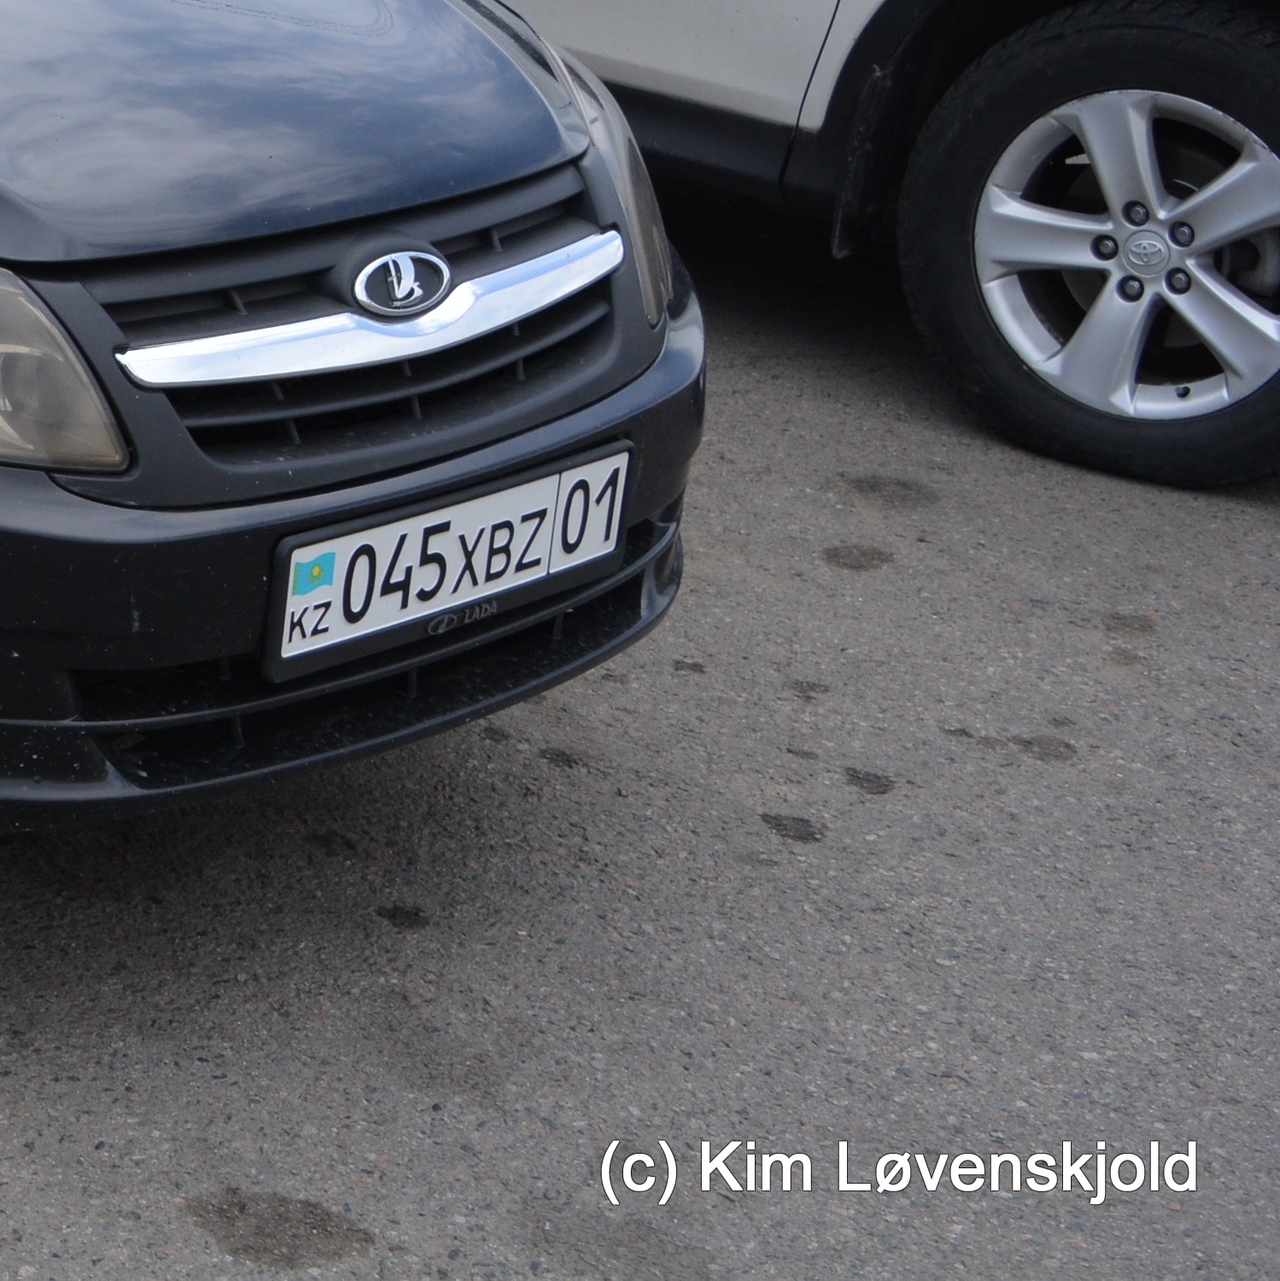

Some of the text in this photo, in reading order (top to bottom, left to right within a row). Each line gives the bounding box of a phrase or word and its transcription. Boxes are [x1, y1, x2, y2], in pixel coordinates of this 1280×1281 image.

[560, 466, 622, 555] 01
[287, 600, 333, 644] KZ
[463, 600, 498, 624] LADA
